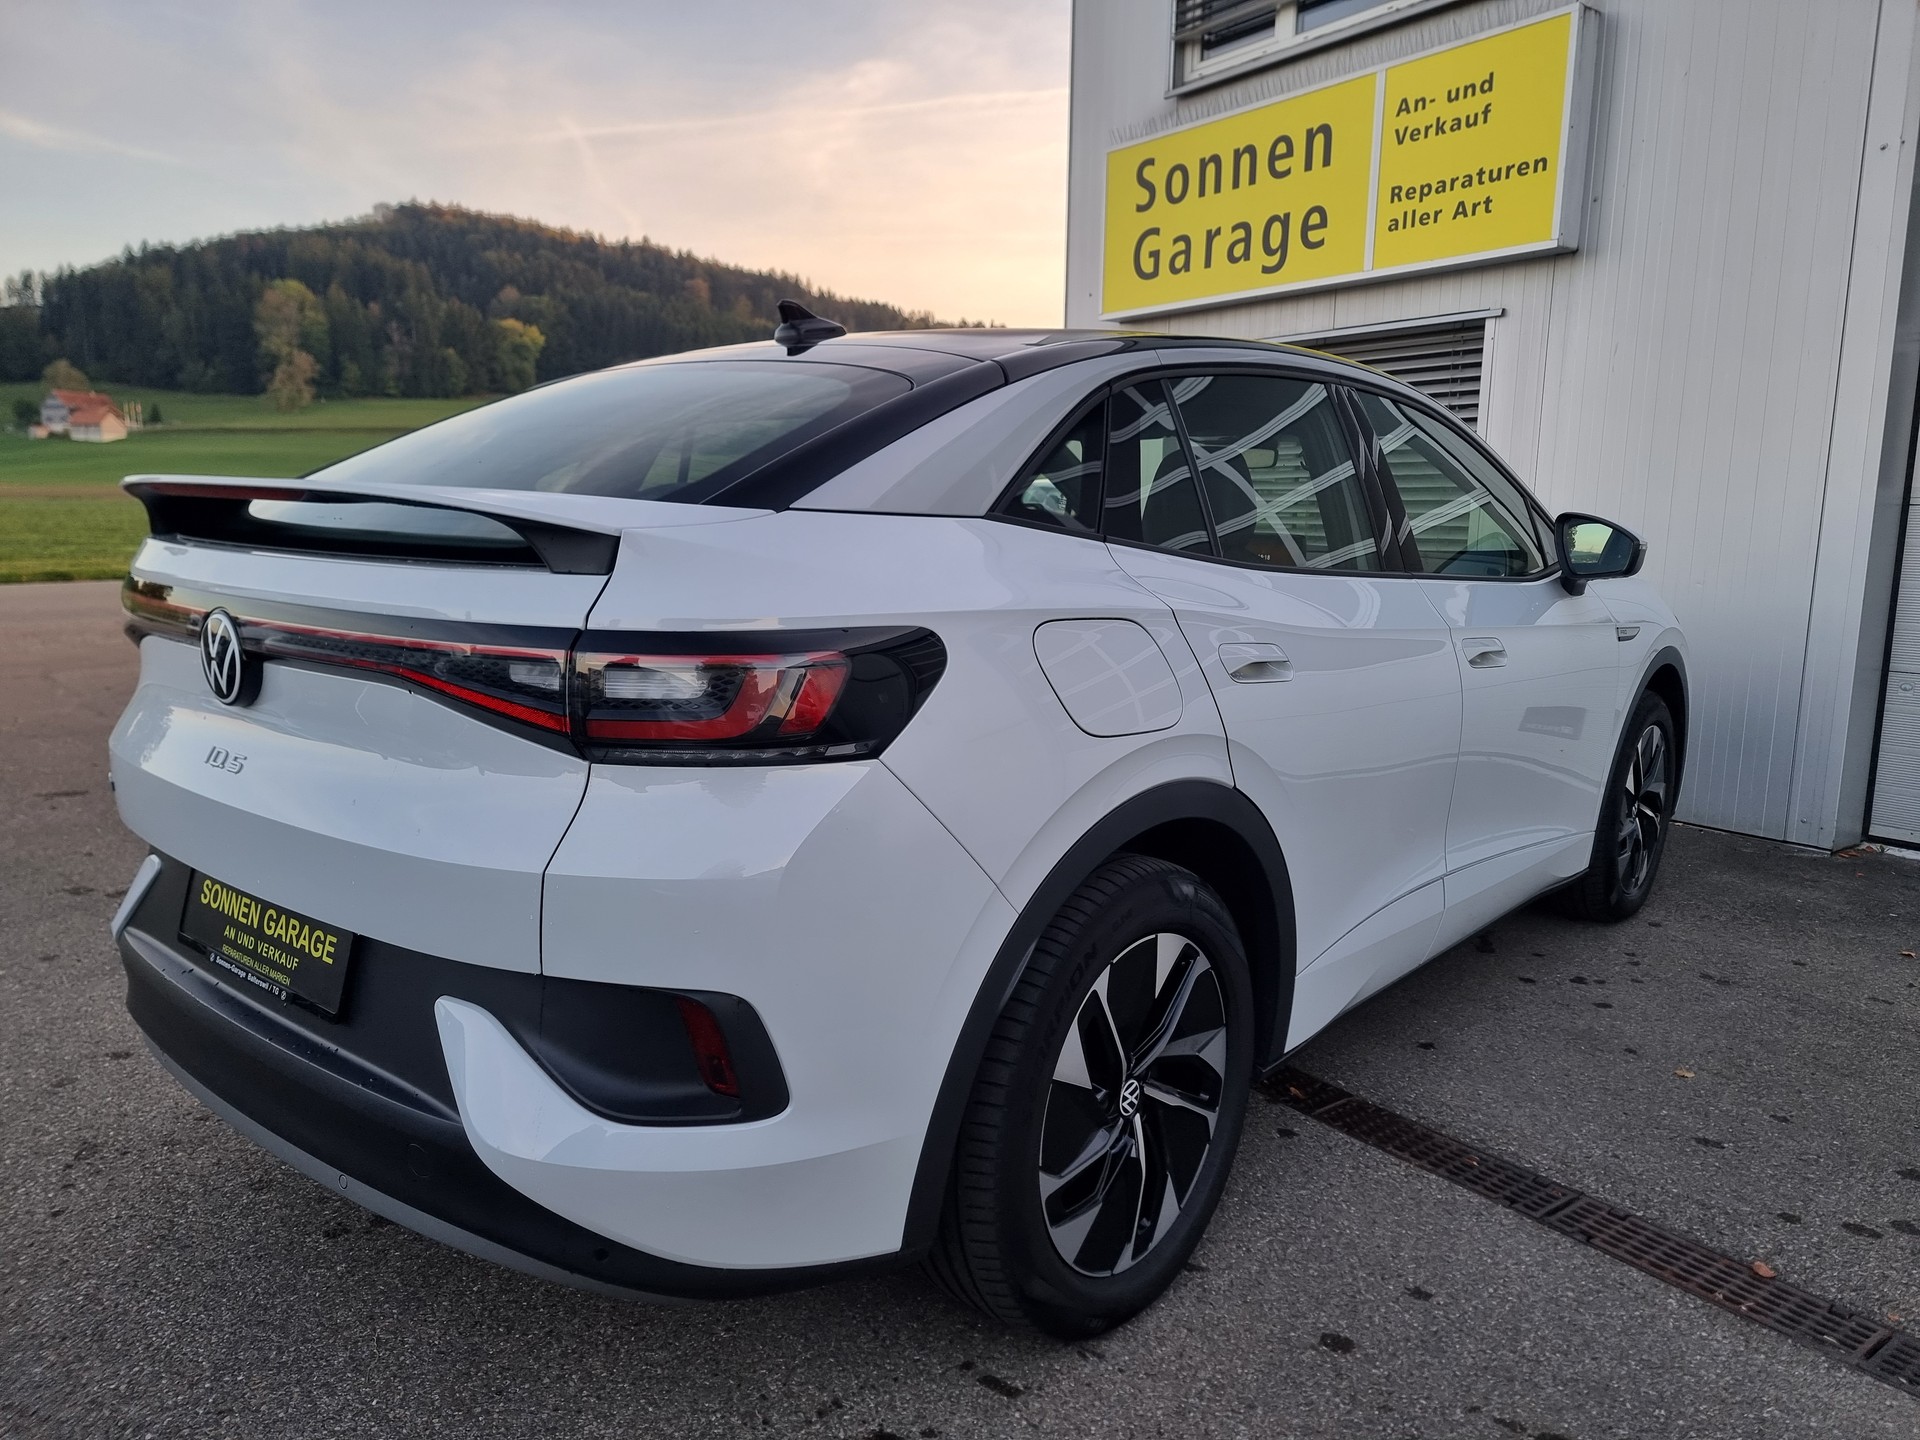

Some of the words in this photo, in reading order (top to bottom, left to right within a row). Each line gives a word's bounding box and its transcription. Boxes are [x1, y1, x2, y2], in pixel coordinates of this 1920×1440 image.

[1395, 96, 1437, 118] An-
[1446, 72, 1494, 104] und
[1394, 104, 1492, 146] Verkauf
[1135, 121, 1333, 213] Sonnen
[1389, 155, 1548, 204] Reparaturen
[1387, 206, 1443, 232] aller
[1452, 195, 1493, 221] Art
[1132, 204, 1329, 281] Garage
[201, 879, 261, 929] SONNEN
[264, 909, 337, 964] GARAGE
[222, 945, 255, 967] REPARATUREN
[254, 962, 270, 975] ALLER
[269, 969, 291, 986] MARKEN
[224, 924, 236, 941] AN
[237, 930, 255, 950] UND
[257, 940, 299, 971] VERKAUF
